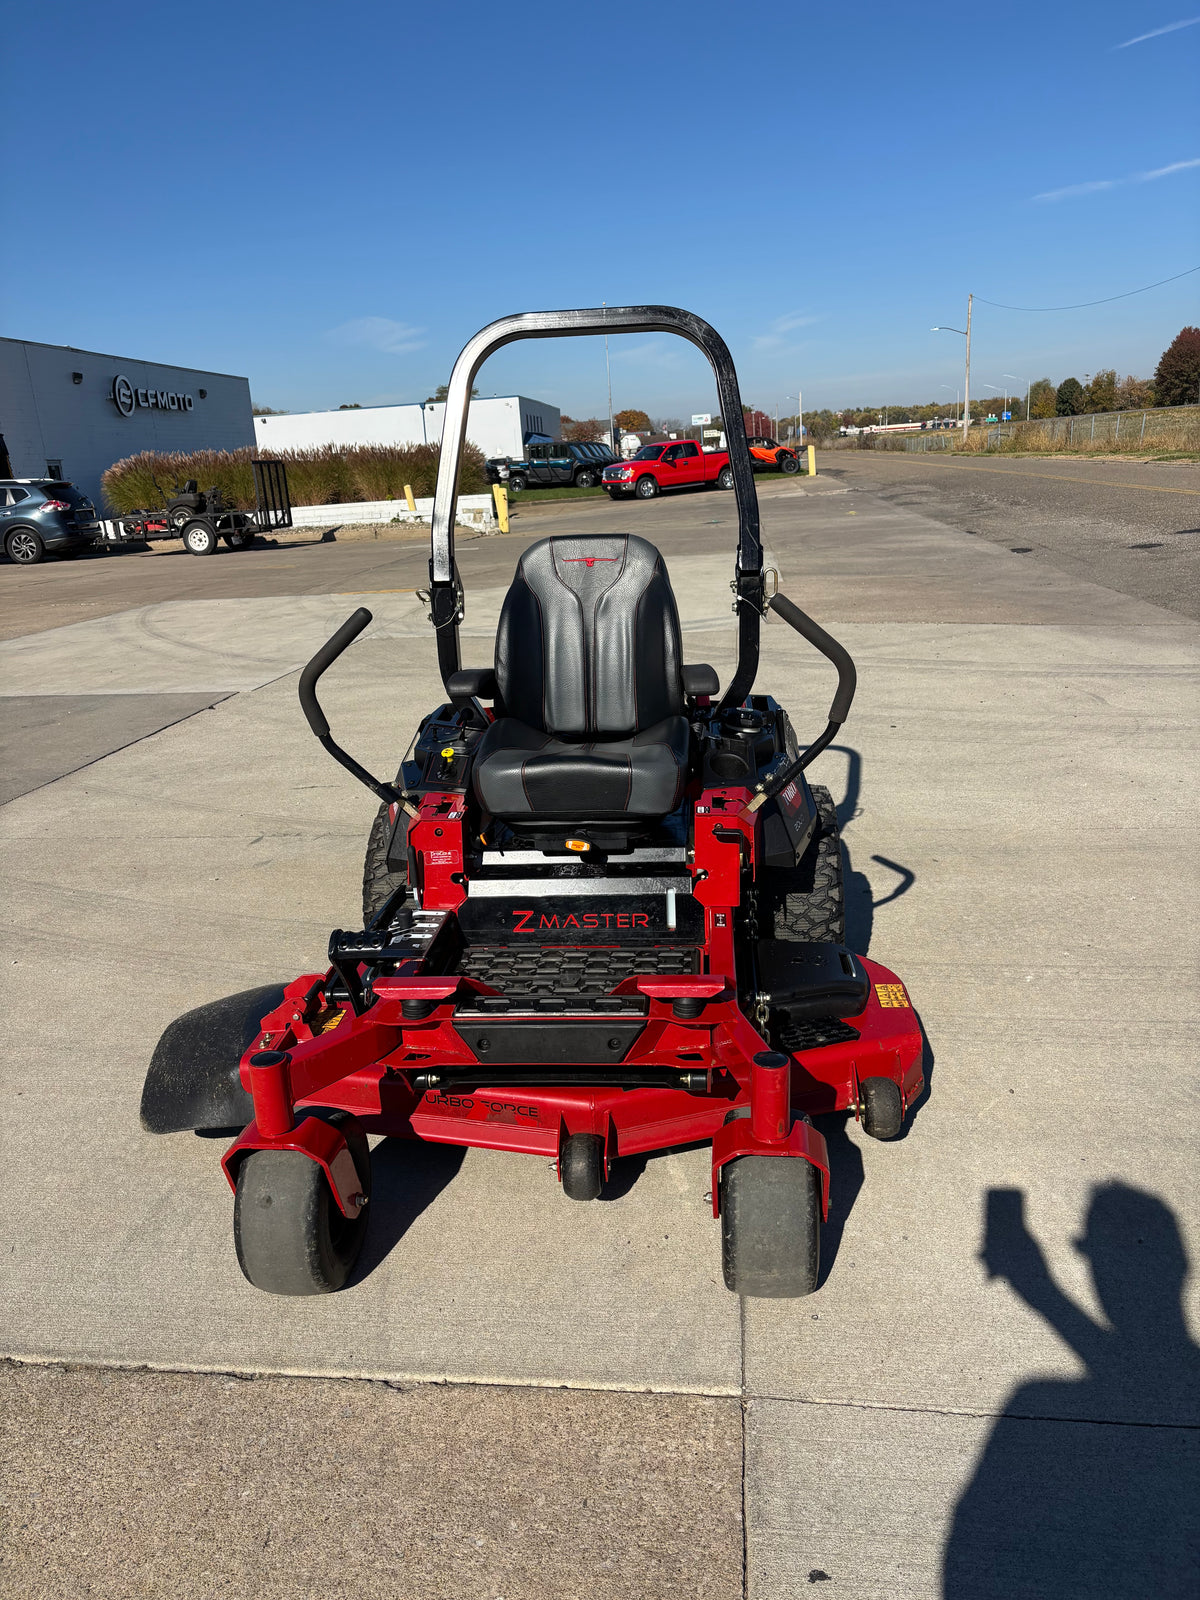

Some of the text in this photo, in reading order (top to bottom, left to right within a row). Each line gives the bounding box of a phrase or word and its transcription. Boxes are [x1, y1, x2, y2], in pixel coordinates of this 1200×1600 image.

[137, 388, 194, 411] CFMOTO
[512, 910, 649, 933] Z MASTER
[424, 1093, 475, 1109] URBO
